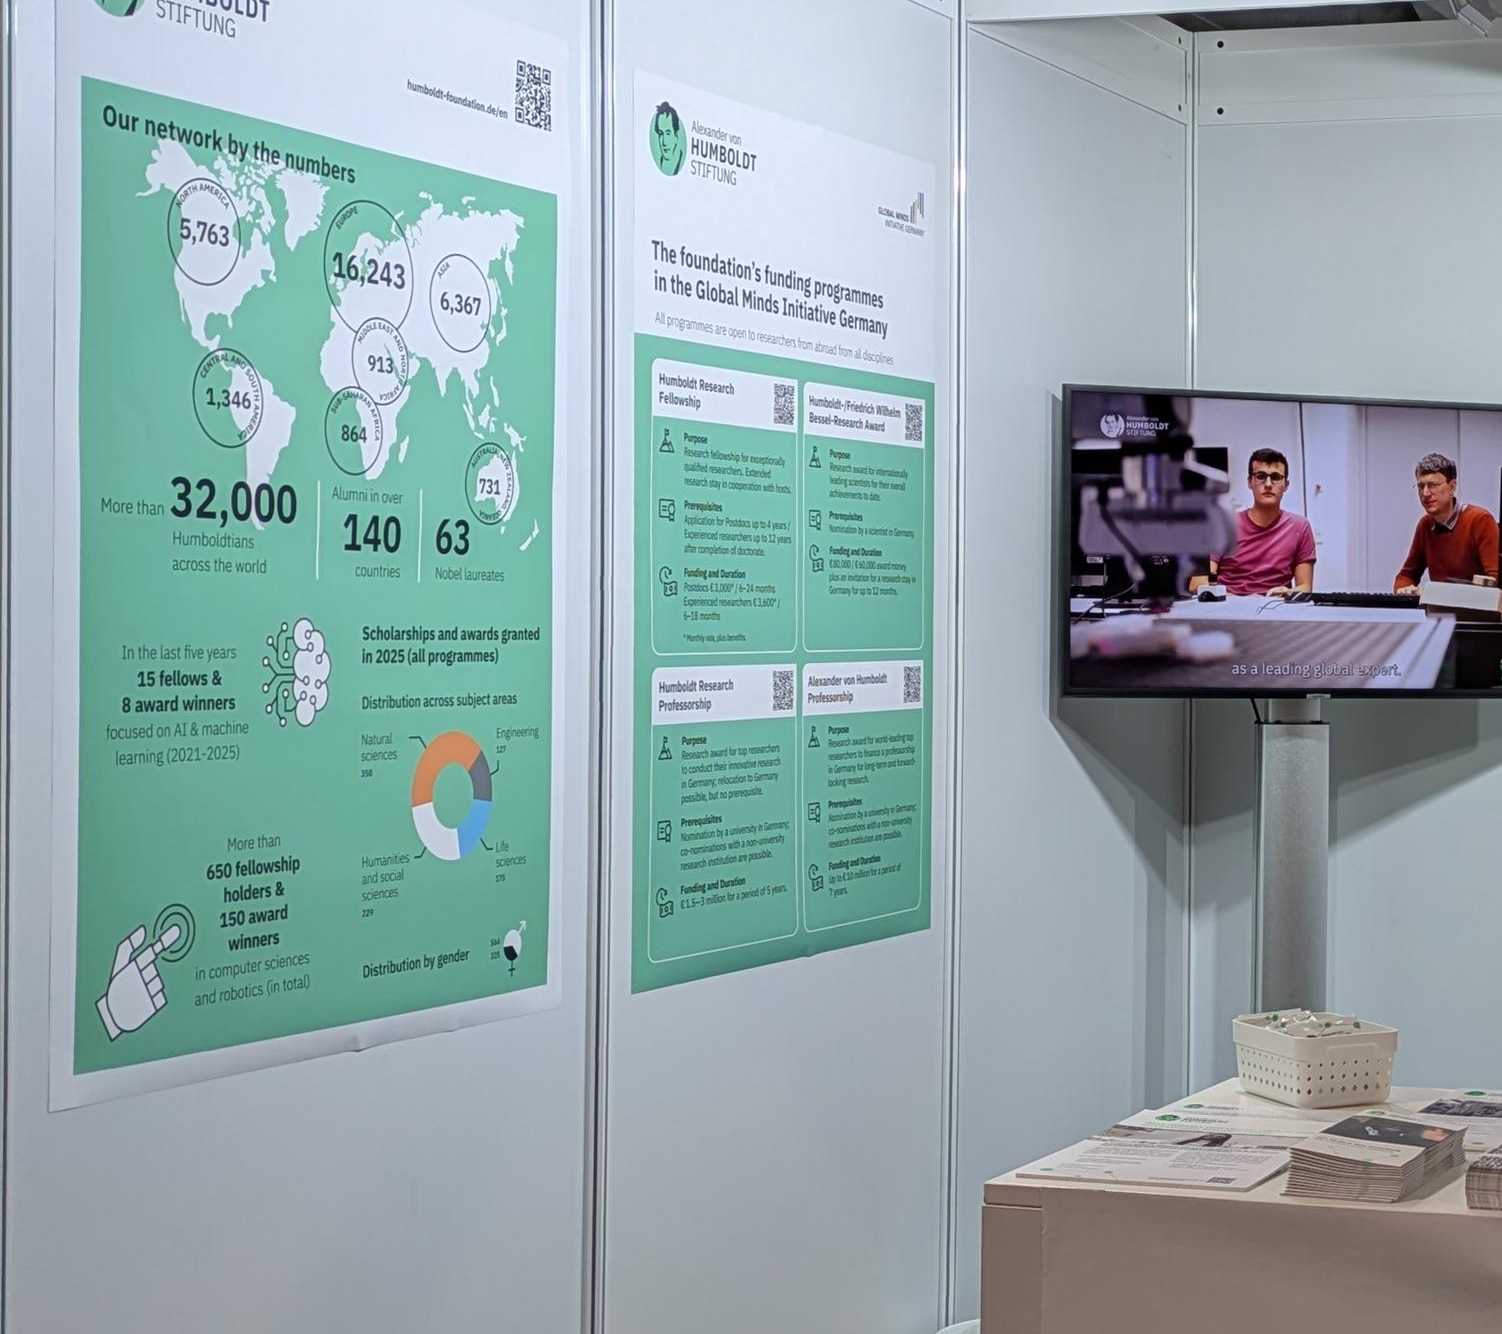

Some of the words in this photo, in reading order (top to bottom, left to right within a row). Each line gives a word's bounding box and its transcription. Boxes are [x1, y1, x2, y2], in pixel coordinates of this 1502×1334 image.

[407, 79, 508, 119] humboldt-foundation.de/en
[691, 121, 727, 141] Alexander
[729, 133, 741, 144] von
[103, 105, 139, 131] Our
[145, 113, 222, 150] network
[227, 133, 248, 157] by
[253, 137, 281, 164] the
[285, 146, 355, 183] numbers
[691, 138, 757, 171] HUMBOLDT
[691, 159, 737, 185] STIFTUNG
[179, 218, 230, 247] 5,763
[332, 251, 406, 290] 16,243
[652, 240, 677, 264] The
[764, 263, 811, 298] funding
[814, 281, 884, 309] programmes
[440, 292, 482, 317] 6,367
[654, 269, 666, 292] in
[670, 273, 693, 297] the
[696, 279, 739, 307] Global
[743, 288, 779, 314] Minds
[783, 297, 836, 325] Initiative
[839, 309, 888, 338] Germany
[367, 354, 394, 374] 913
[659, 373, 698, 393] Humboldt
[699, 379, 734, 395] Research
[206, 388, 252, 409] 1,346
[659, 392, 701, 411] Fellowship
[341, 424, 367, 443] 864
[332, 487, 368, 502] Alumni
[372, 489, 381, 503] in
[383, 492, 402, 505] over
[479, 477, 500, 495] 731
[101, 498, 133, 514] More
[137, 499, 164, 515] than
[170, 477, 298, 527] 32,000
[172, 531, 254, 549] Humboldtians
[343, 514, 401, 553] 140
[435, 519, 470, 555] 63
[172, 558, 210, 572] across
[214, 557, 232, 573] the
[236, 559, 267, 574] world
[355, 564, 401, 580] countries
[435, 566, 462, 582] Nobel
[464, 567, 504, 583] laureates
[362, 626, 435, 643] Scholarships
[437, 626, 457, 641] and
[460, 626, 499, 641] awards
[501, 625, 540, 644] granted
[122, 646, 134, 660] In
[138, 645, 156, 660] the
[160, 645, 181, 660] last
[184, 645, 203, 659] five
[205, 645, 236, 663] years
[362, 650, 373, 663] in
[376, 648, 405, 665] 2025
[407, 648, 426, 666] (all
[427, 647, 498, 666] programmes)
[137, 672, 155, 688] 15
[159, 670, 207, 688] fellows
[211, 671, 222, 686] &
[1232, 666, 1245, 675] as
[1250, 666, 1257, 675] a
[1262, 663, 1310, 678] leading
[1315, 664, 1353, 678] global
[658, 681, 698, 693] Humboldt
[699, 678, 733, 692] Research
[122, 698, 131, 713] 8
[135, 696, 177, 713] award
[181, 694, 236, 713] winners
[658, 698, 712, 712] Professorship
[207, 862, 232, 880] 650
[236, 856, 300, 878] fellowship
[224, 883, 272, 903] holders
[275, 882, 284, 898] &
[220, 909, 244, 929] 150
[249, 905, 288, 925] award
[229, 931, 279, 952] winners
